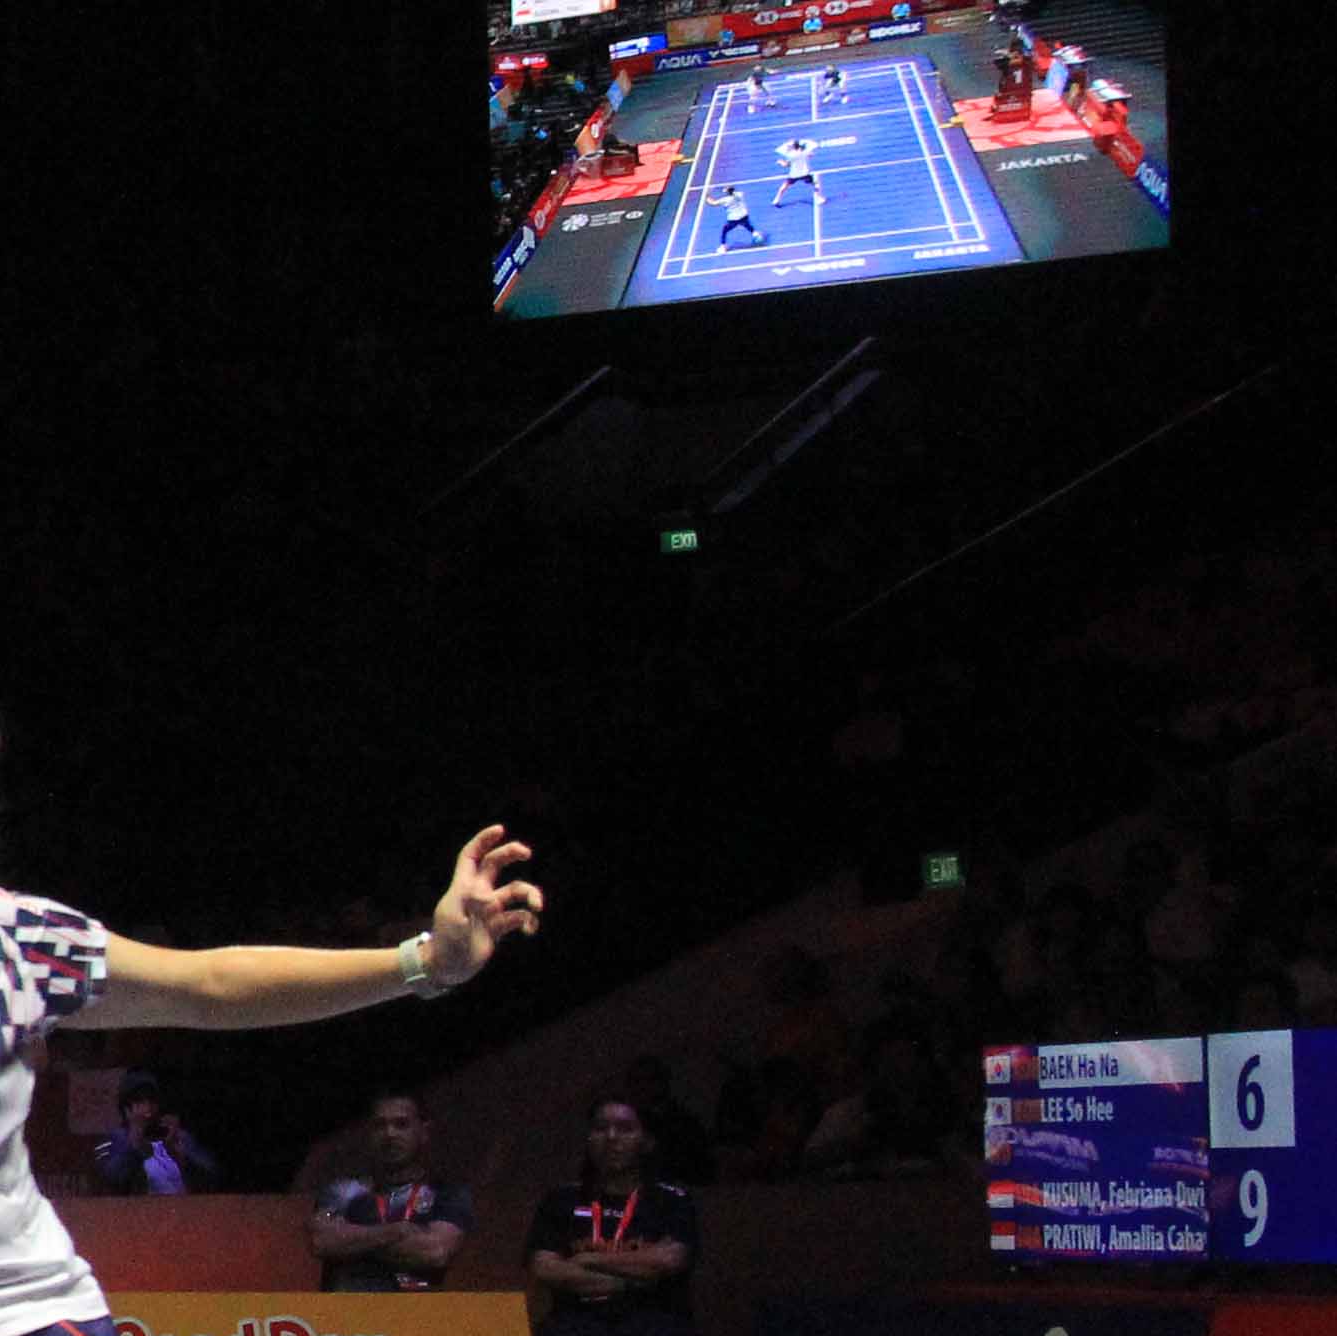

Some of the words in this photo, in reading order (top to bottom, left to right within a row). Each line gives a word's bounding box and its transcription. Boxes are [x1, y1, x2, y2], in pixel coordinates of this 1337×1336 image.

[657, 52, 703, 70] AQUA
[995, 153, 1090, 171] JAKARTA
[1039, 1056, 1076, 1081] BAEK
[1079, 1055, 1097, 1079] Ha
[1101, 1055, 1119, 1078] Na
[1236, 1054, 1265, 1131] 6
[1041, 1097, 1064, 1122] LEE
[1065, 1097, 1083, 1121] So
[1086, 1096, 1114, 1121] Hee
[1109, 1180, 1173, 1206] Febriana
[1175, 1179, 1205, 1206] Dwi
[1239, 1169, 1268, 1247] 9
[1109, 1224, 1165, 1250] Amallia
